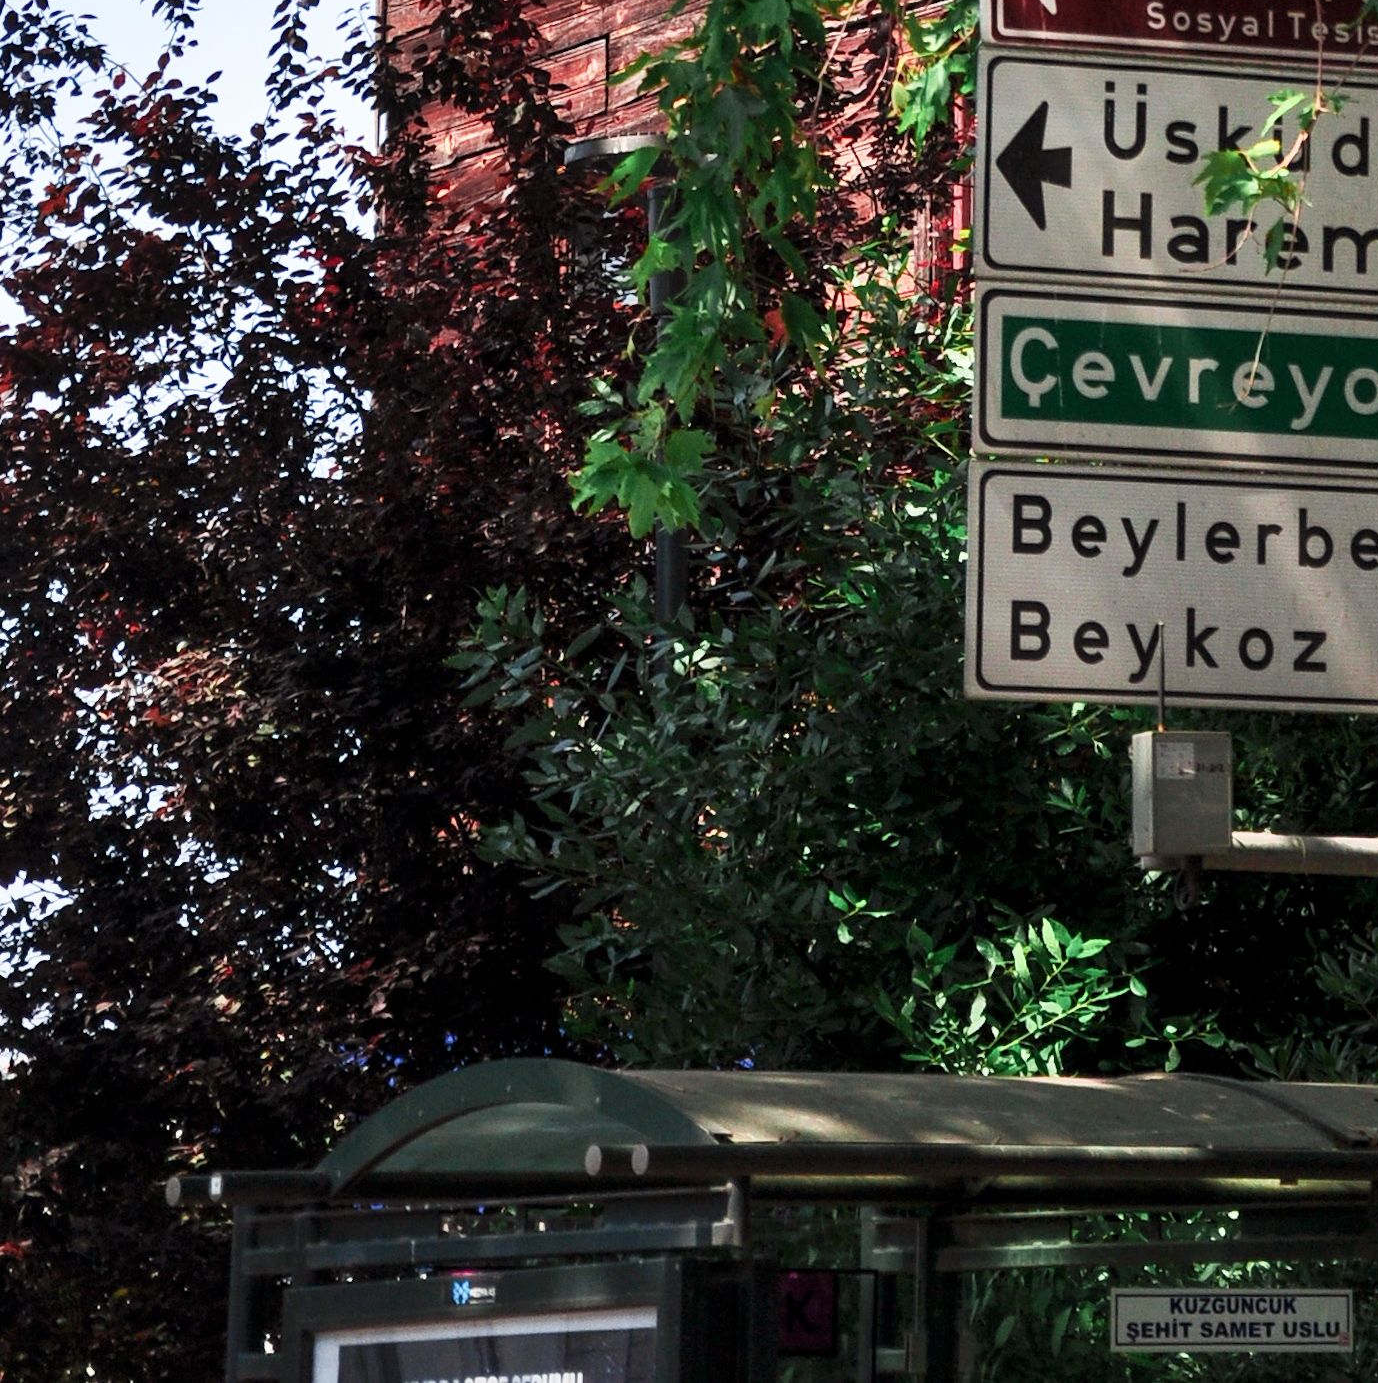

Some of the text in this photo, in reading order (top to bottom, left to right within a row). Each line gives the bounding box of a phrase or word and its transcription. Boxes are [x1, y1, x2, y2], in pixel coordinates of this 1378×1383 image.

[1146, 1, 1274, 42] Sosyal
[1010, 600, 1328, 684] Beykoz
[1169, 1297, 1298, 1315] KUZGUNCUK
[1126, 1318, 1341, 1342] ŞEHİT SAMET USLU
